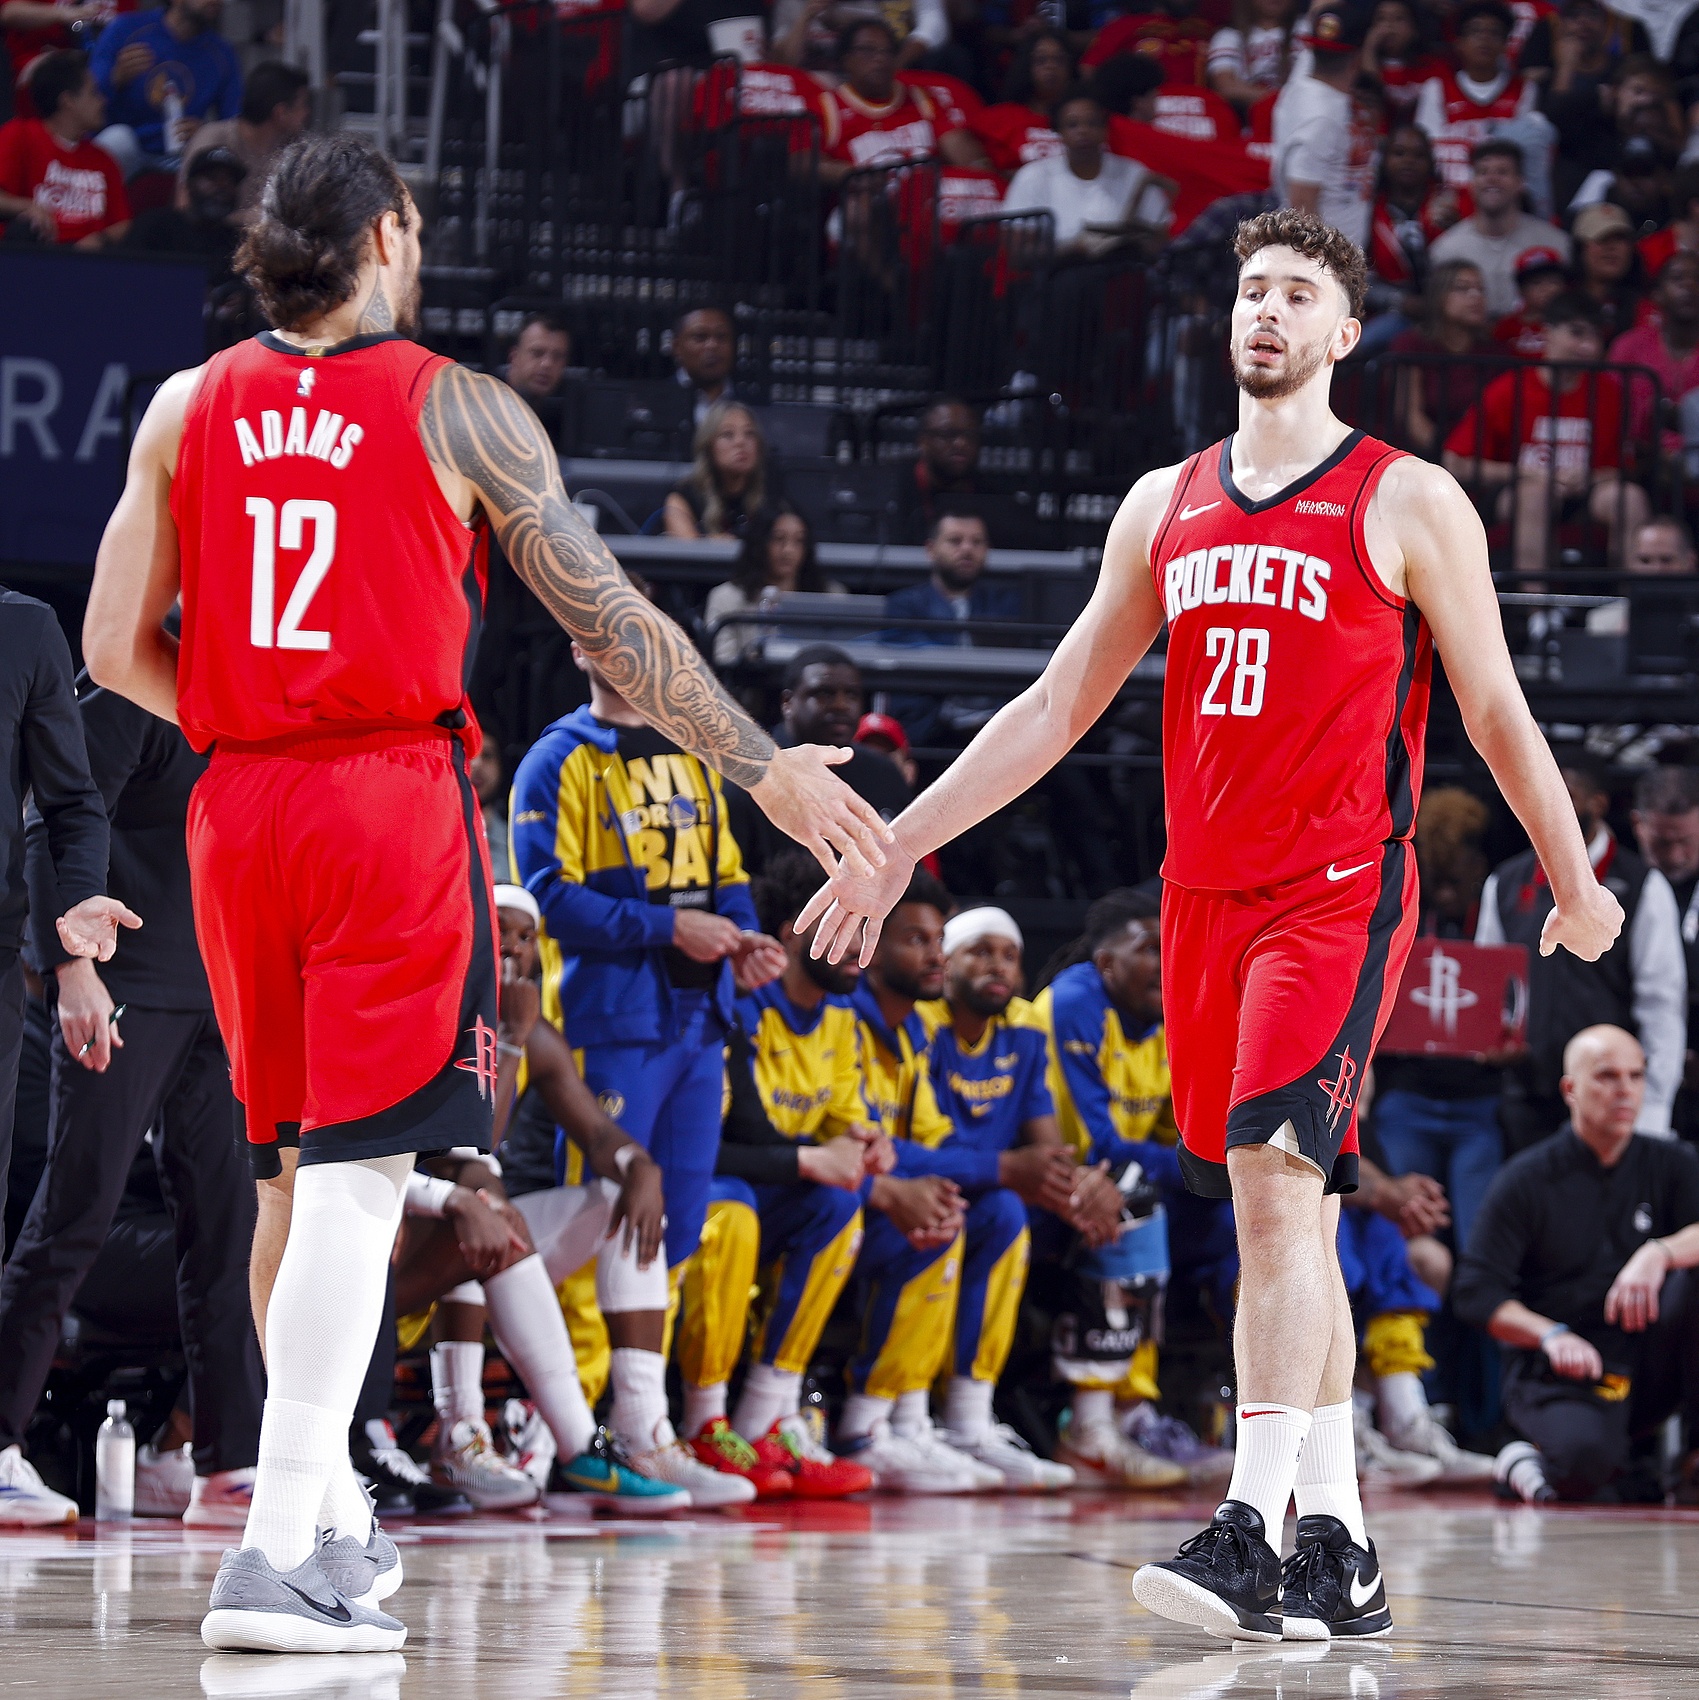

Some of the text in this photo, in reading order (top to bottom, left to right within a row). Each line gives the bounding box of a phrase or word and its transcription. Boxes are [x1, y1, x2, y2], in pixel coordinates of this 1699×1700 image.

[234, 406, 365, 470] ADAMS
[245, 496, 337, 650] 12
[1164, 543, 1332, 623] ROCKETS
[1200, 627, 1270, 717] 28
